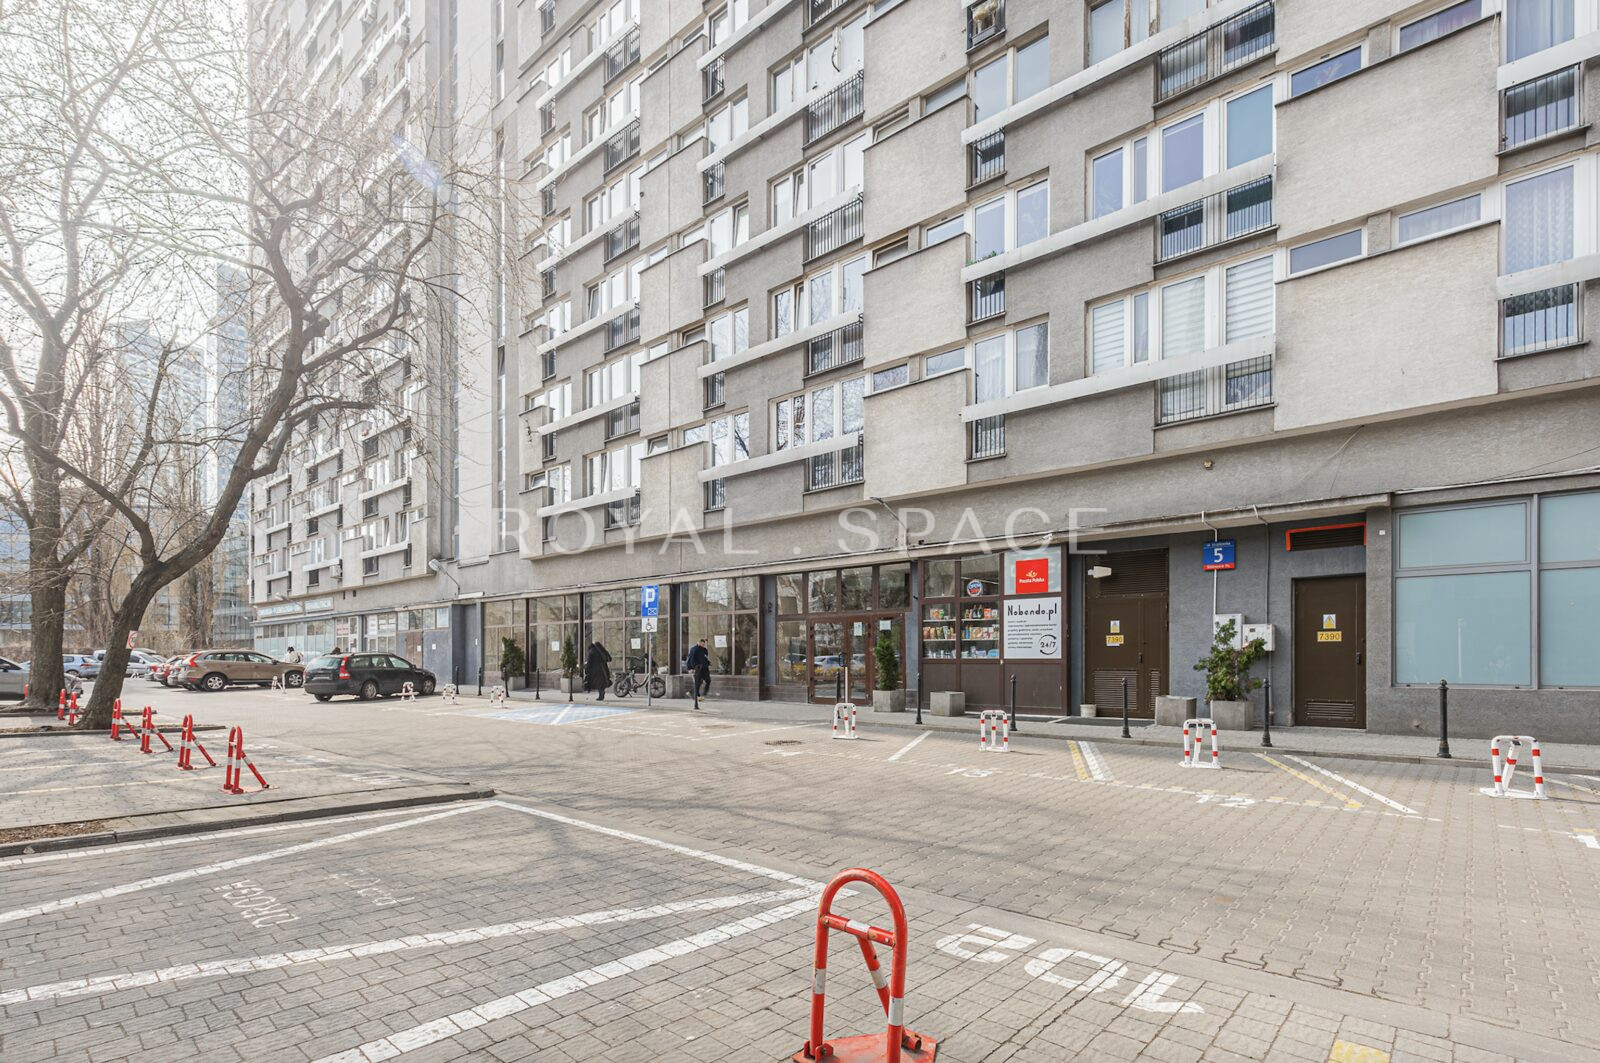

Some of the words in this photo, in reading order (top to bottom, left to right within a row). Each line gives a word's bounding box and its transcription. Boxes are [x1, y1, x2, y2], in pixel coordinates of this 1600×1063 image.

[1213, 548, 1224, 563] 5
[645, 588, 656, 608] P
[1319, 633, 1341, 641] 7390
